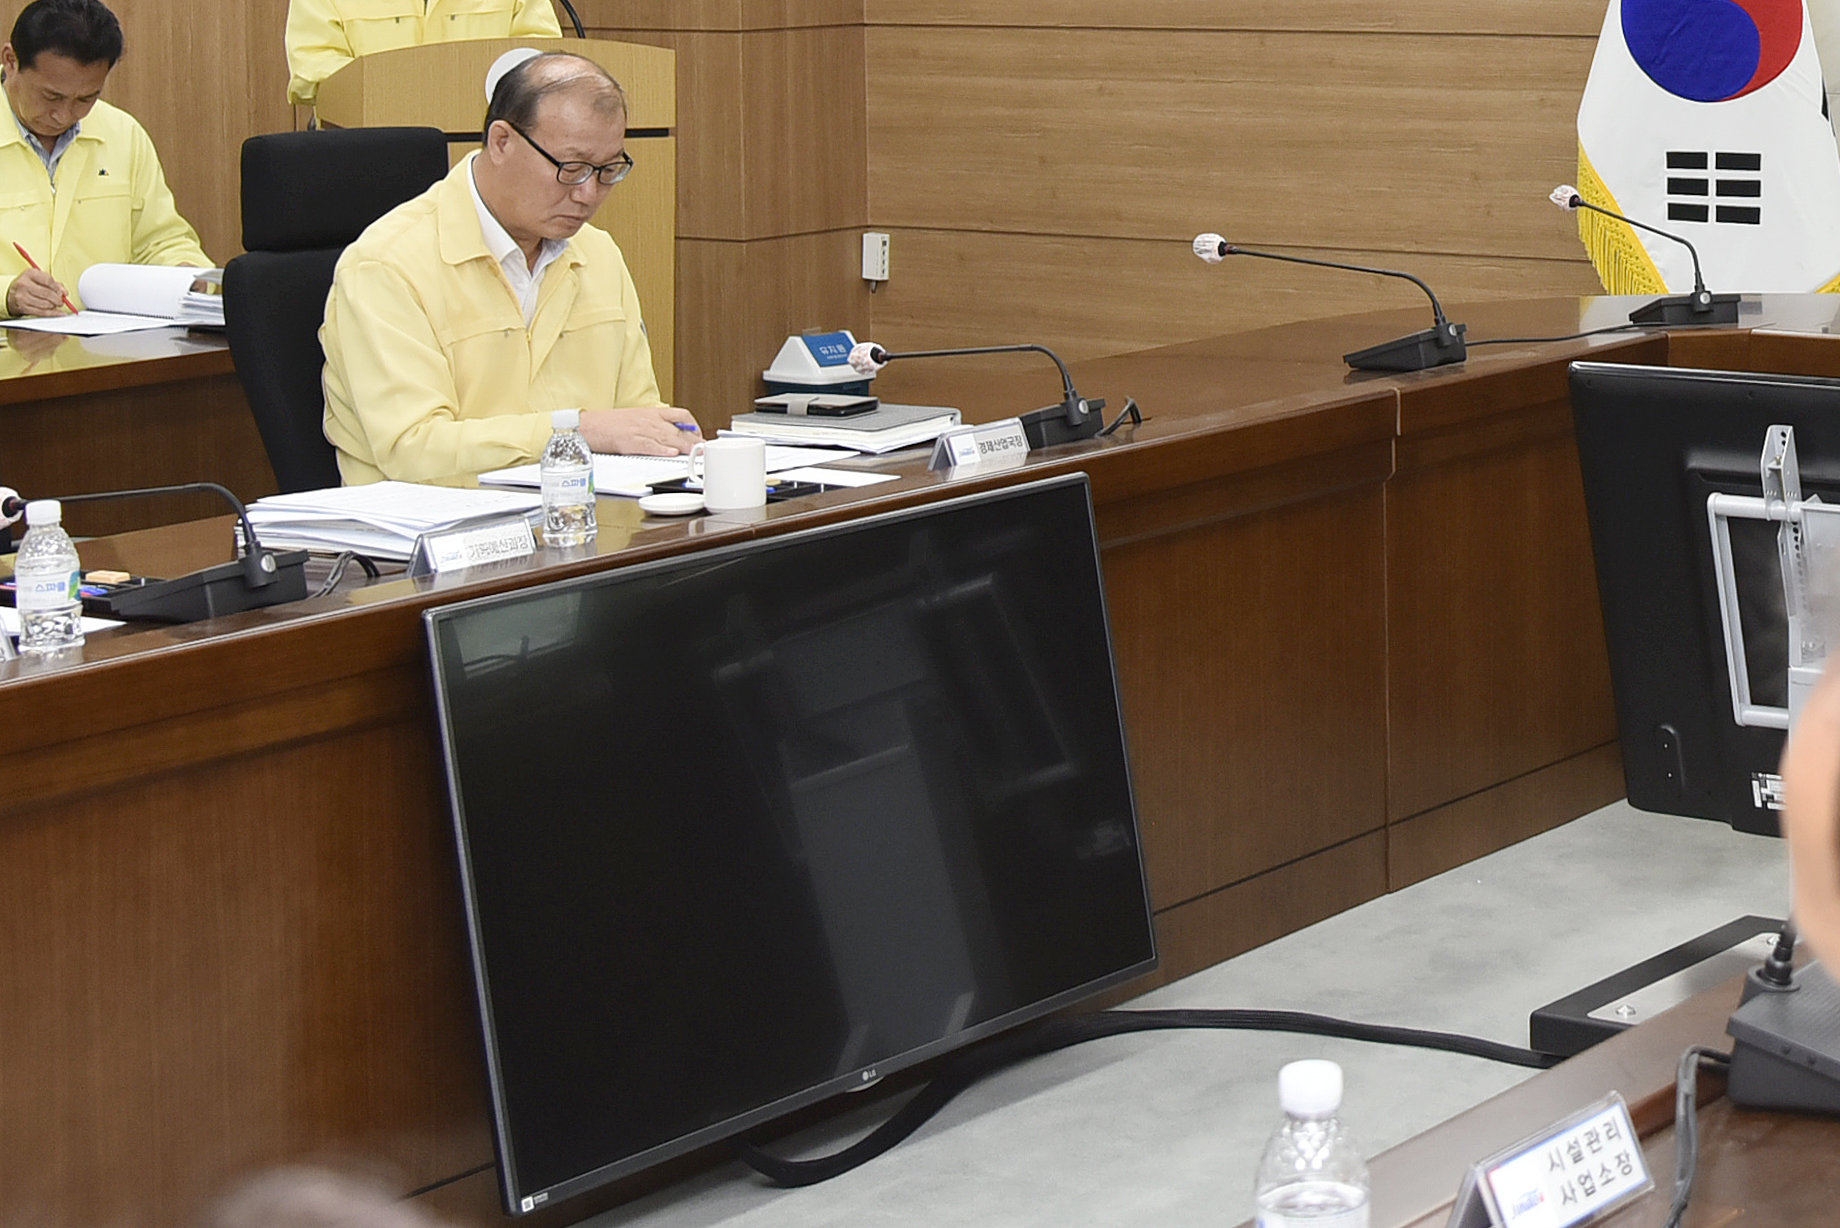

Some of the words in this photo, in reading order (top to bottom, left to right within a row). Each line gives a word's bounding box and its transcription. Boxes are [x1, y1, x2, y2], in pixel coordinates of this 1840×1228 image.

[978, 434, 1024, 455] 경제산업국장
[468, 534, 529, 558] 기획예산과장
[1548, 1116, 1622, 1172] 시설관리
[1559, 1149, 1634, 1205] 사업소장
